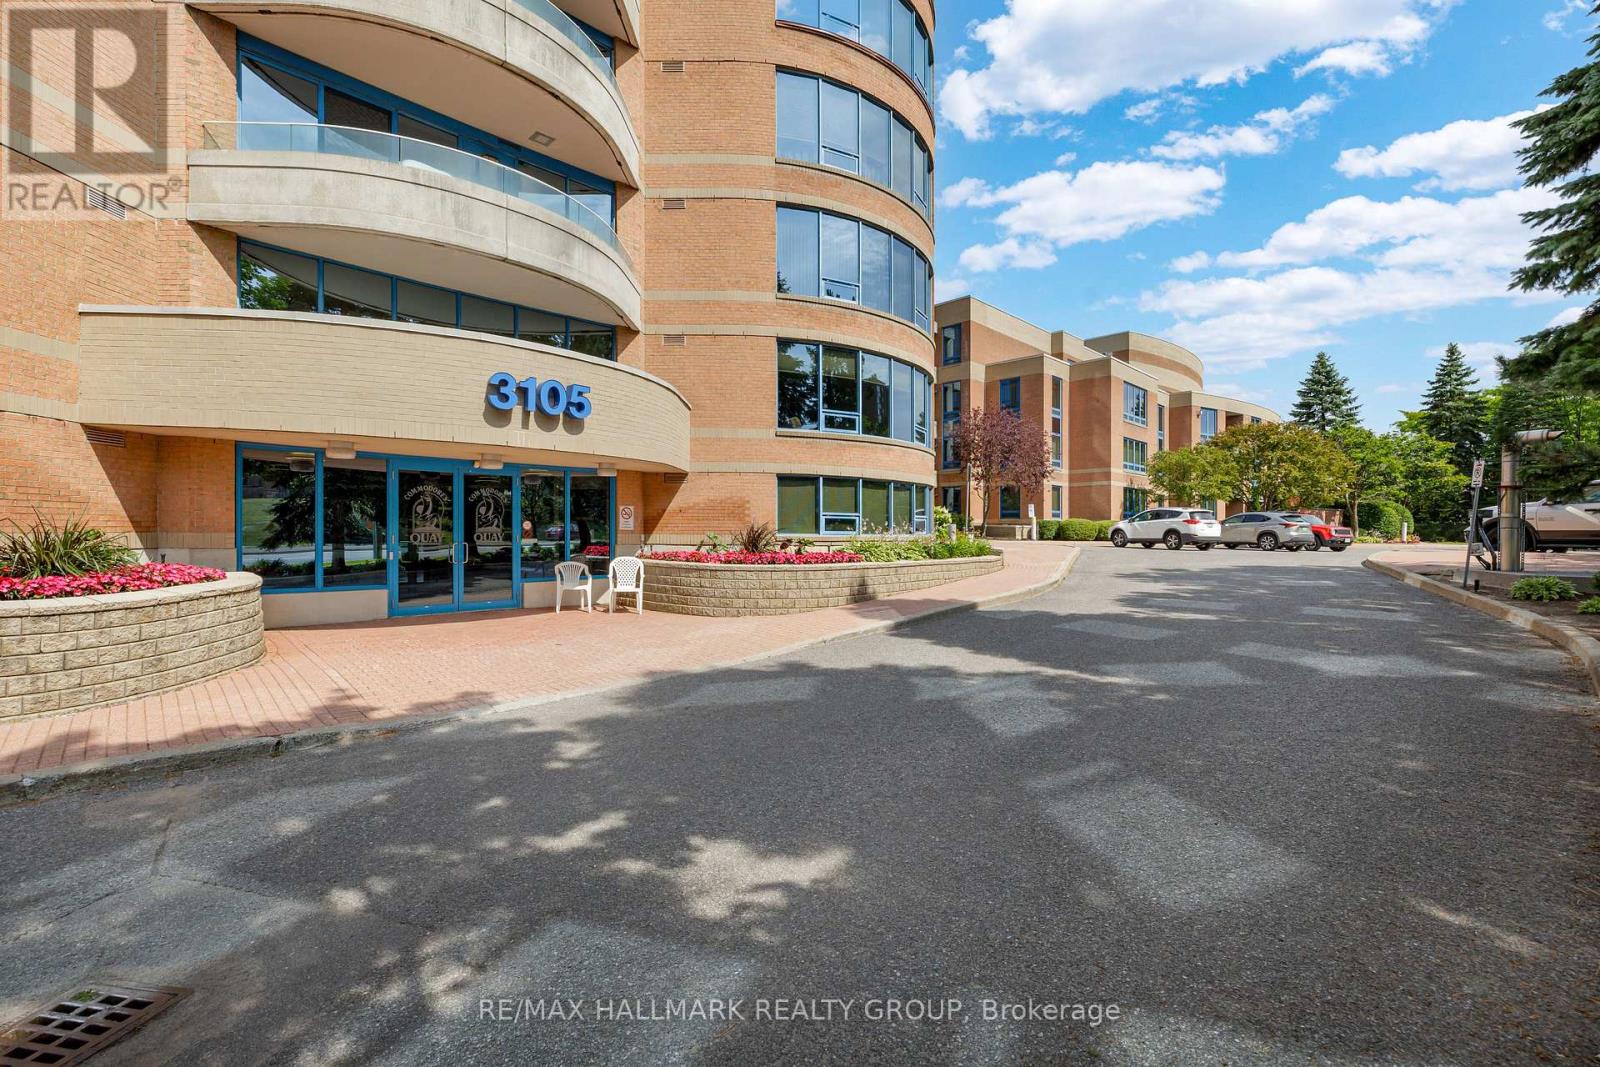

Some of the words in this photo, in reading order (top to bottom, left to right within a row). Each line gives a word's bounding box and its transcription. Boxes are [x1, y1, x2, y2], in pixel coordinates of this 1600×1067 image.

[487, 372, 592, 419] 3105
[410, 532, 443, 545] QUAY
[474, 532, 504, 543] QUAY
